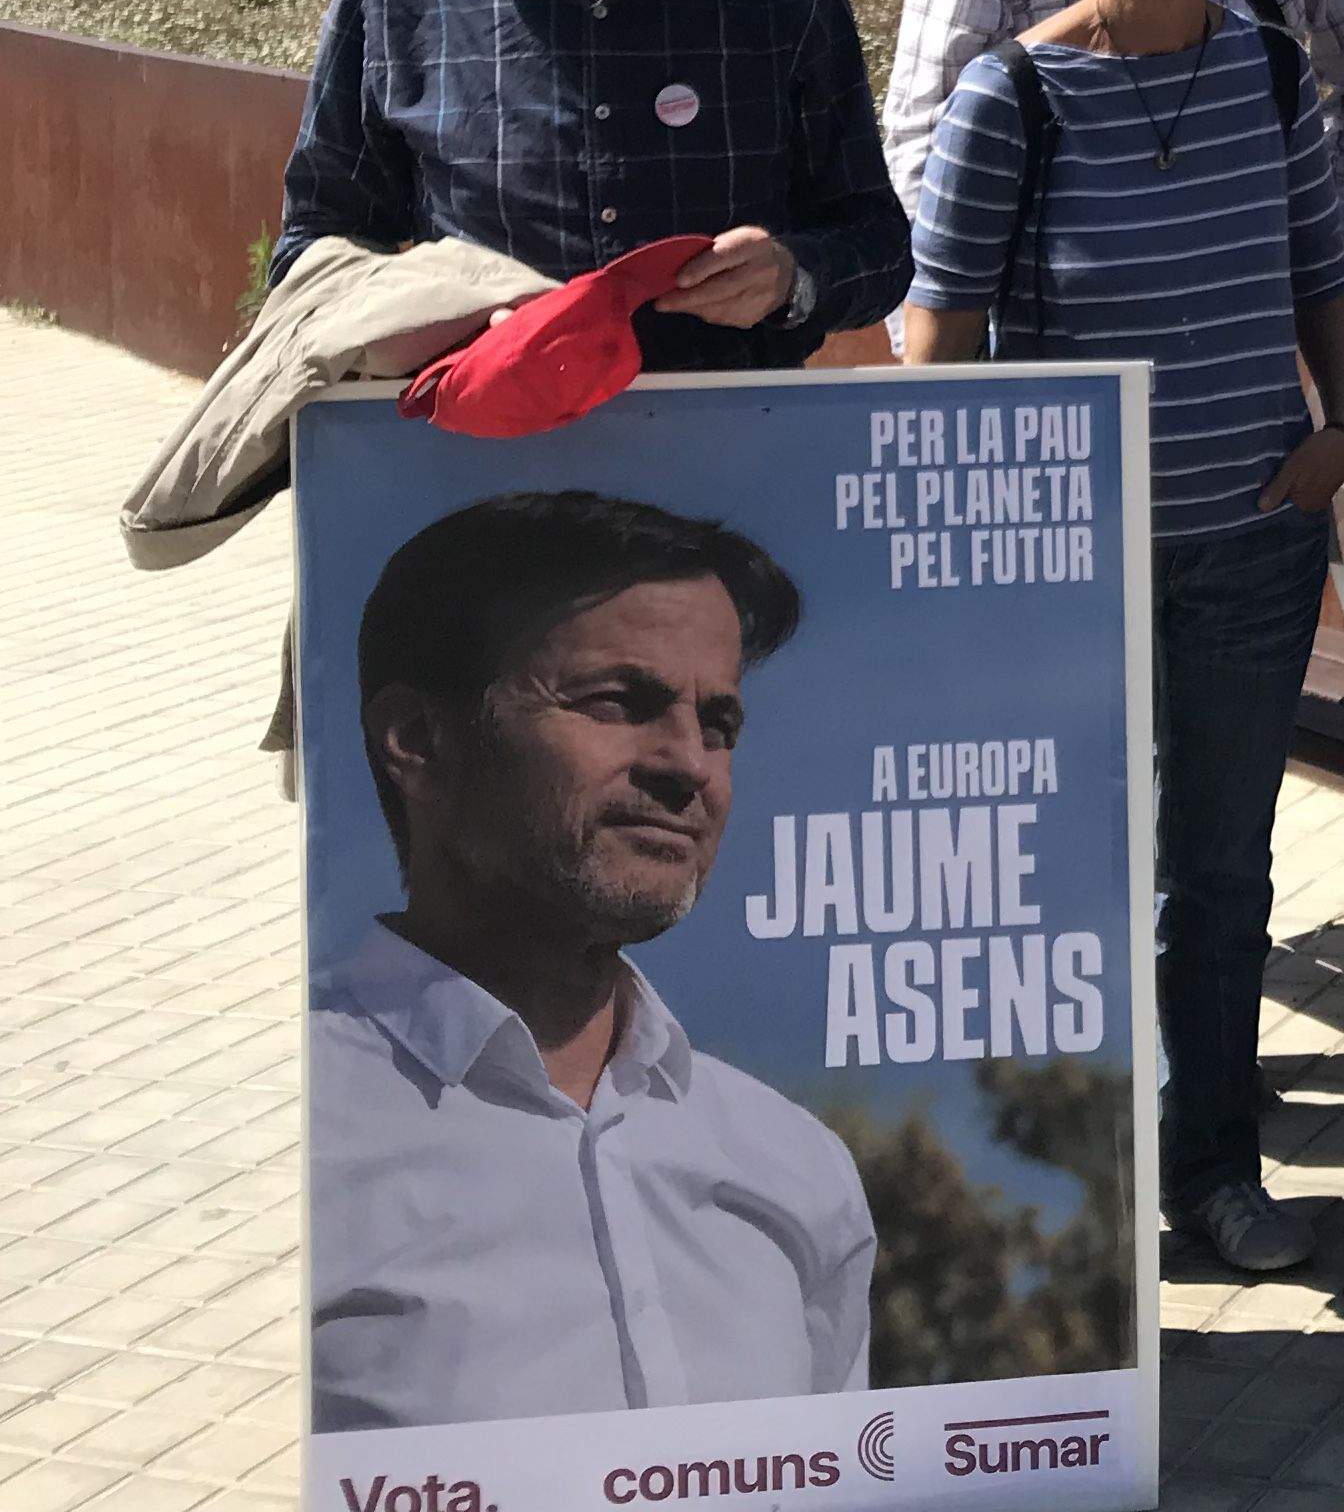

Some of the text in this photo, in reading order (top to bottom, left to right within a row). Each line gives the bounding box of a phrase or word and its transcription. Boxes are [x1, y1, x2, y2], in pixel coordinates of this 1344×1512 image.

[870, 404, 1092, 468] PER LA PAU
[835, 465, 1093, 530] PEL PLANETA
[890, 525, 1094, 589] PEL FUTUR
[872, 738, 1058, 802] A EUROPA
[745, 803, 1042, 939] JAUME
[825, 931, 1104, 1068] ASENS
[603, 1451, 841, 1505] comuns
[944, 1433, 1110, 1477] Sumar
[338, 1474, 499, 1512] Vota.
